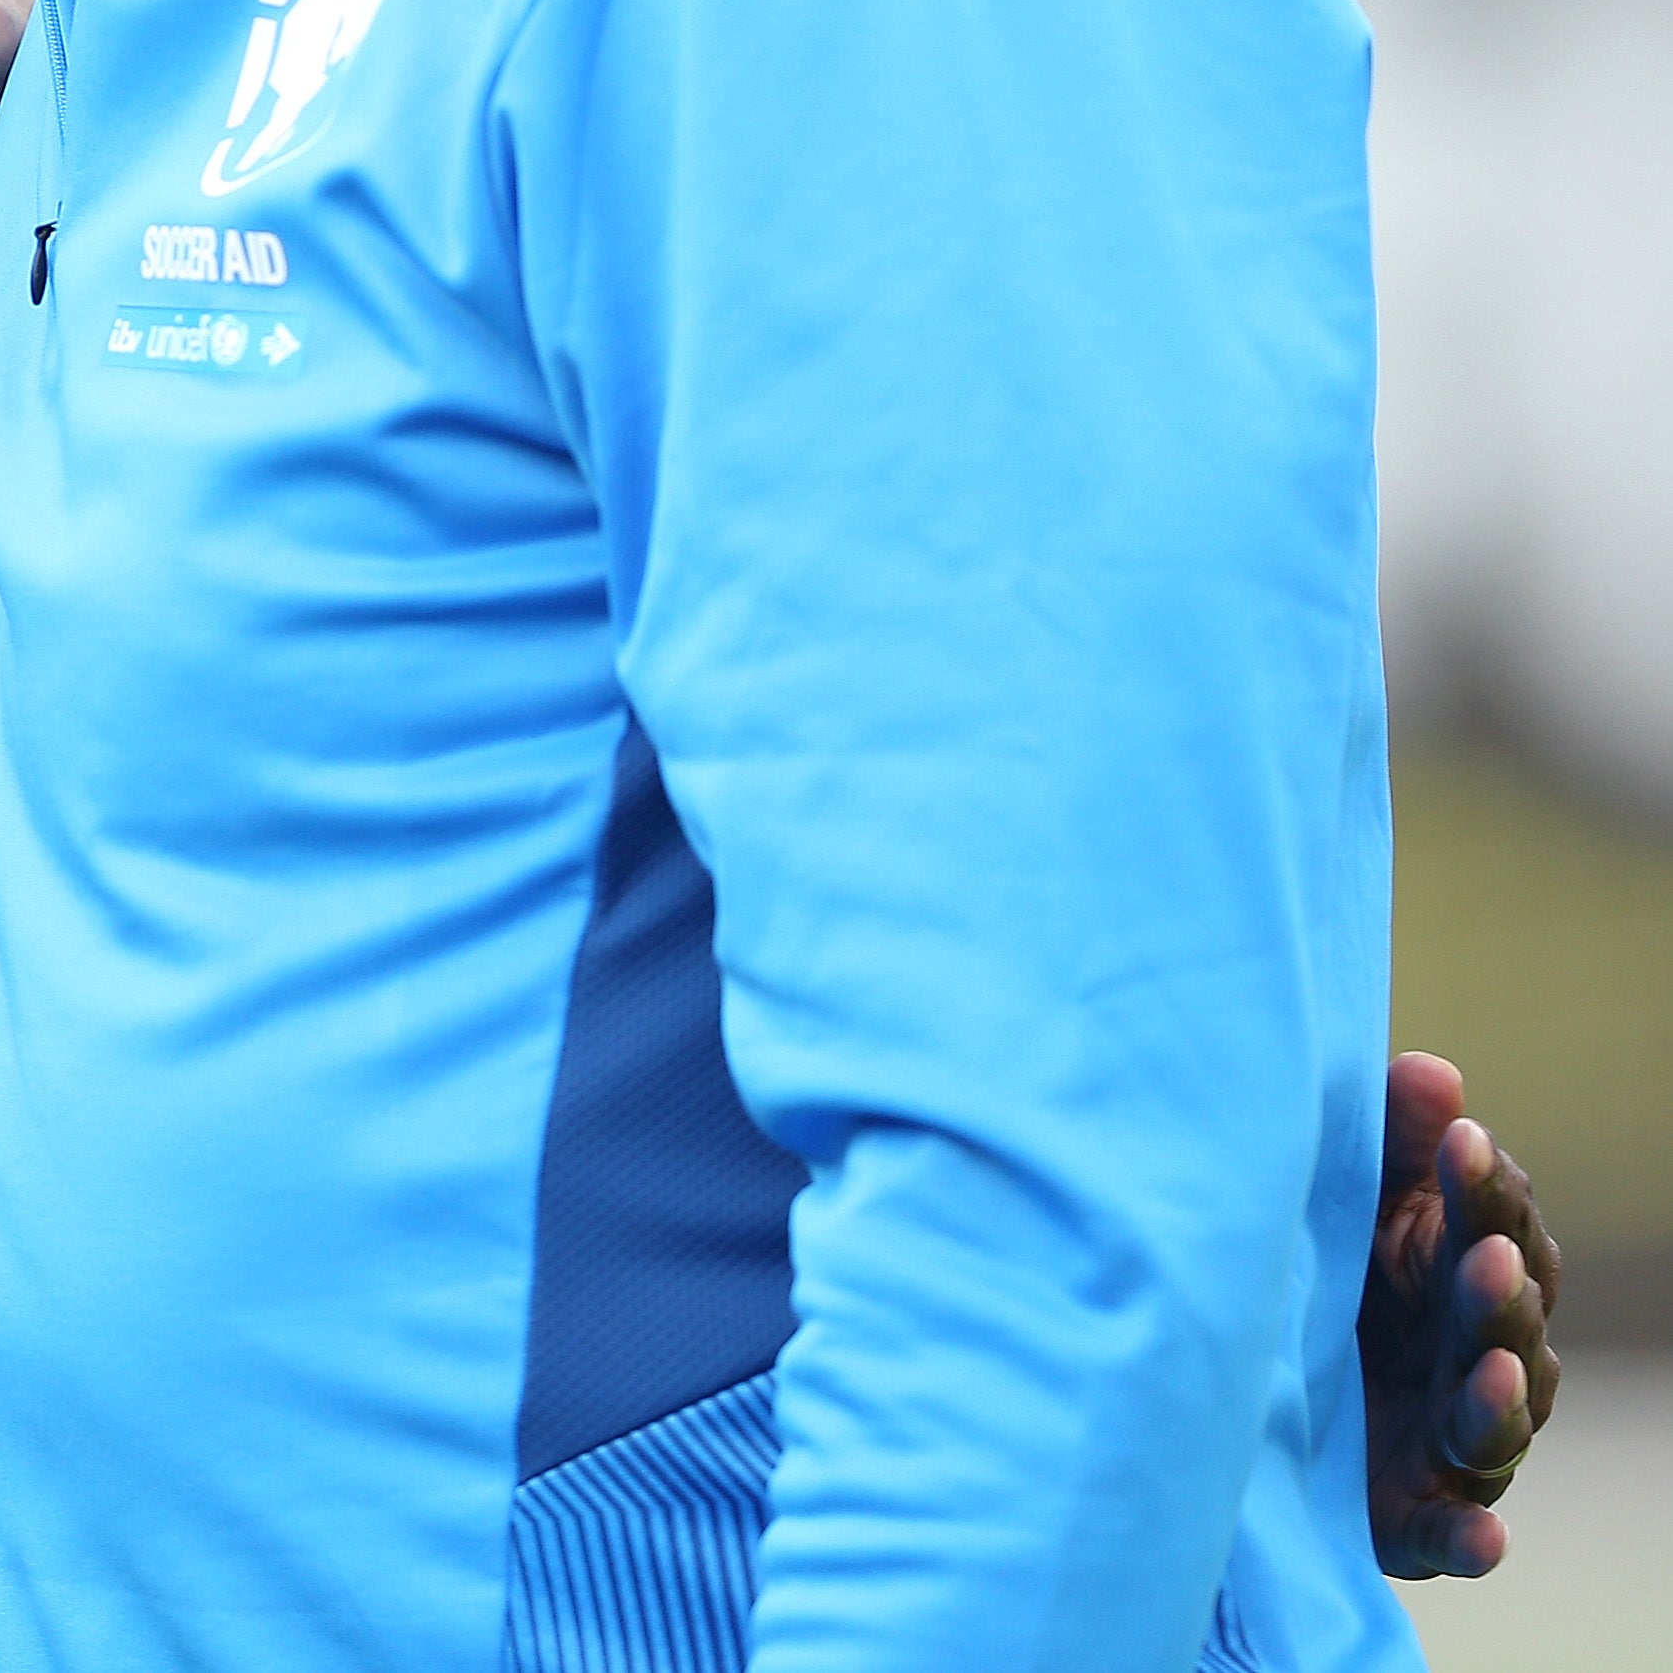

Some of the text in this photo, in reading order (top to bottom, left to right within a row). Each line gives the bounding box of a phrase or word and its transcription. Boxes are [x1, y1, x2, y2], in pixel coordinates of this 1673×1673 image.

[140, 224, 289, 286] SOCCER AID
[145, 314, 212, 362] unicef
